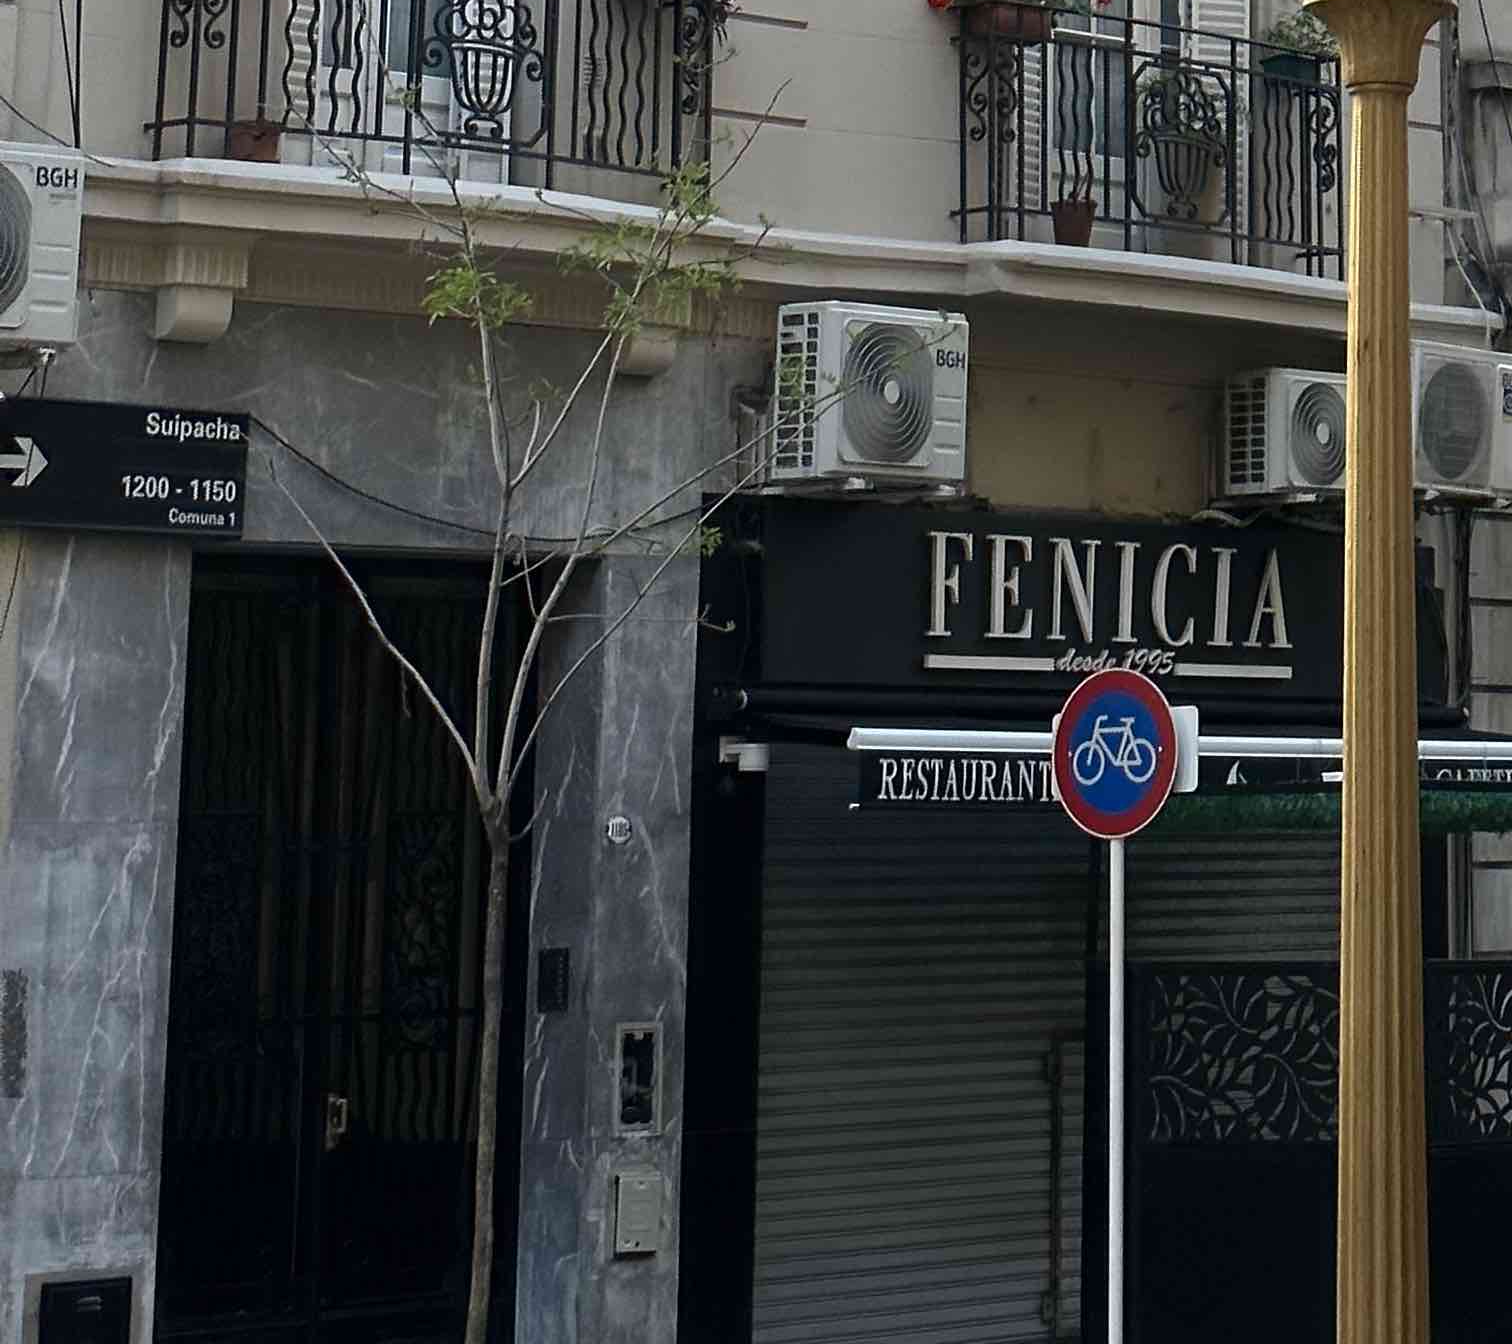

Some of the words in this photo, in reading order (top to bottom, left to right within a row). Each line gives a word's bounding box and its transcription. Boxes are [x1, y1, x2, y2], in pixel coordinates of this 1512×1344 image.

[36, 166, 78, 188] BGH
[936, 349, 966, 369] BGH
[146, 412, 241, 442] Suipacha
[122, 475, 169, 499] 1200
[190, 478, 236, 503] 1150
[168, 507, 225, 526] Comuna
[229, 512, 236, 526] 1
[924, 529, 1294, 649] FENICIA
[1056, 647, 1117, 672] desde
[1123, 648, 1176, 675] 1995
[877, 758, 1052, 802] RESTAURANT
